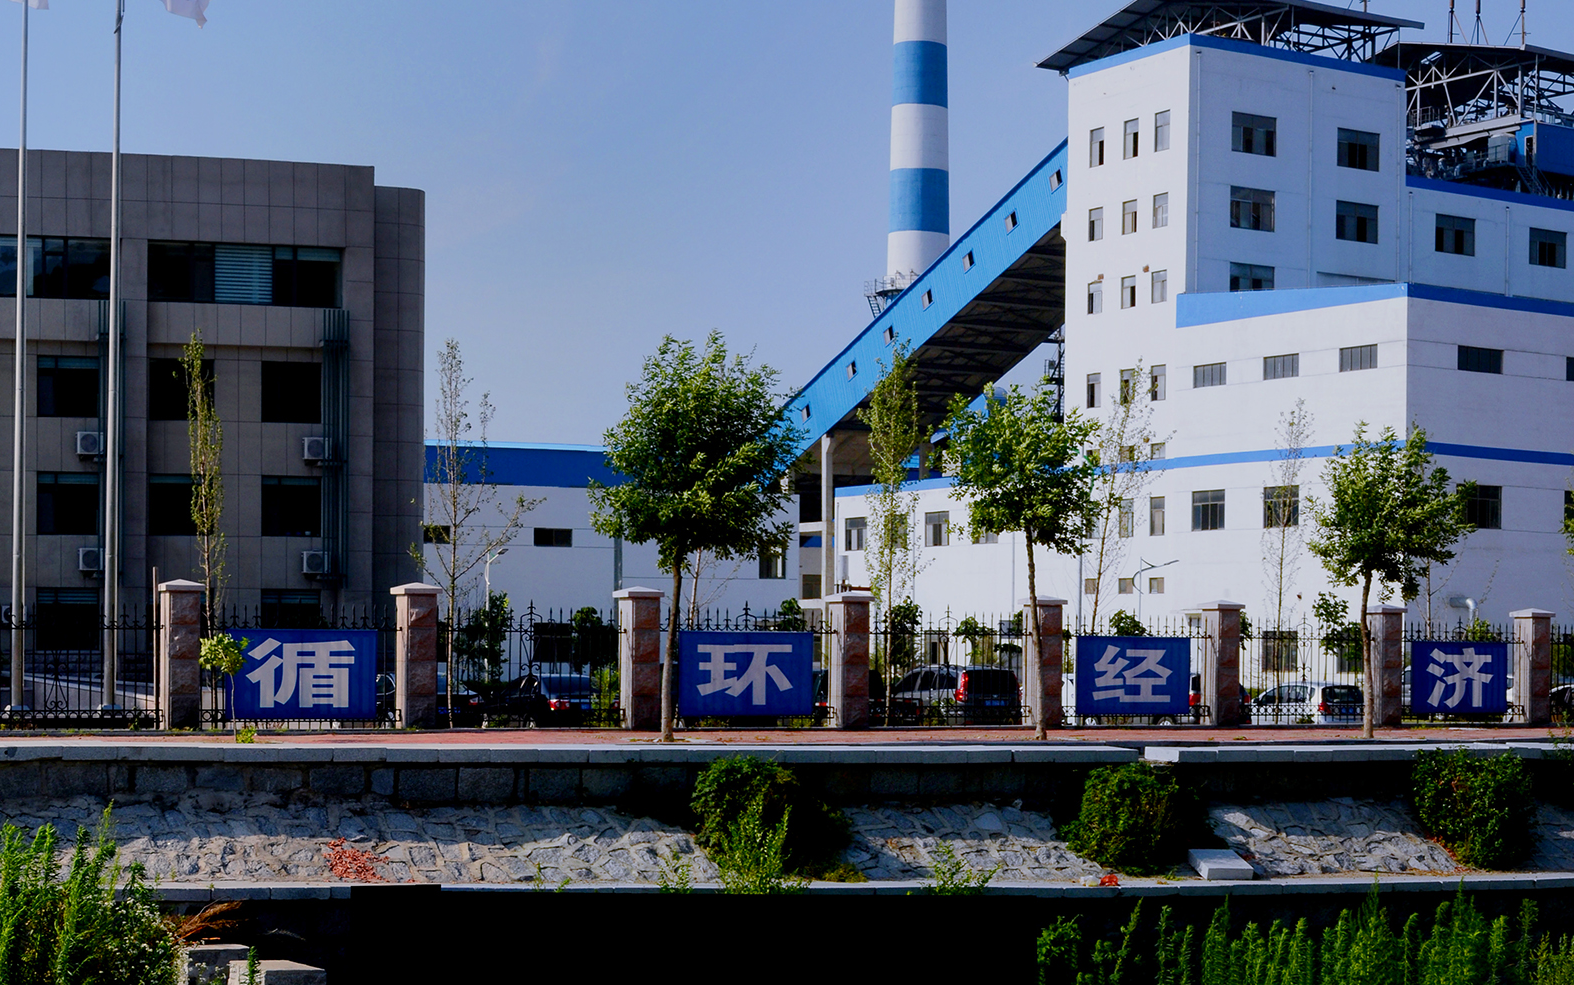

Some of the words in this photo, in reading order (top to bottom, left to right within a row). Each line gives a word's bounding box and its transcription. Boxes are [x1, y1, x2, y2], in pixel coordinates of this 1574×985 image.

[246, 637, 355, 708] 循
[696, 643, 793, 705] 环
[1092, 644, 1172, 703] 经
[1427, 647, 1494, 707] 济
